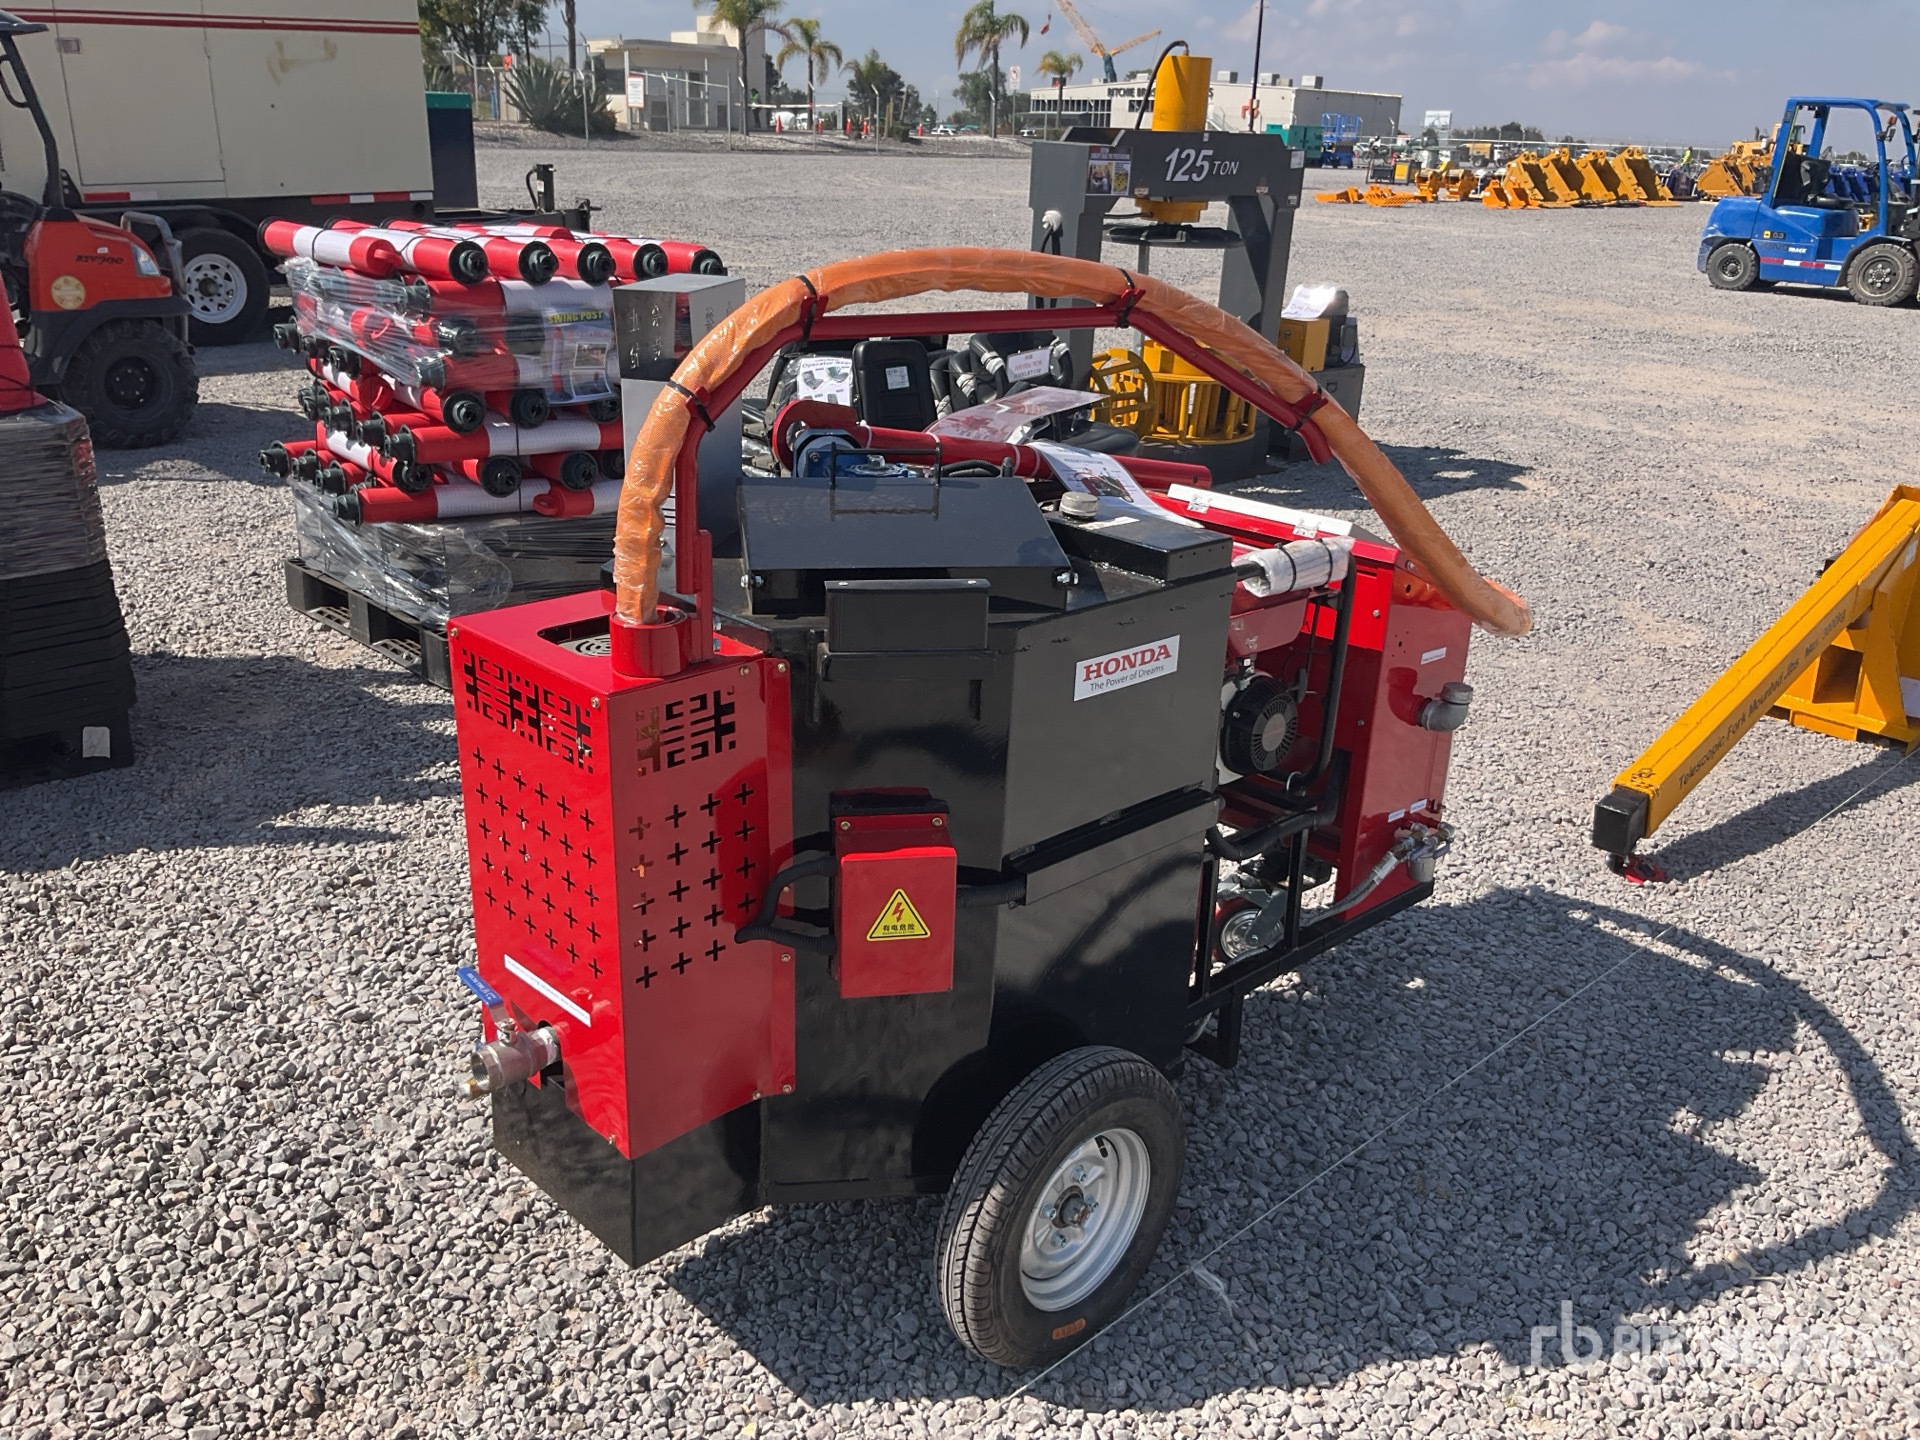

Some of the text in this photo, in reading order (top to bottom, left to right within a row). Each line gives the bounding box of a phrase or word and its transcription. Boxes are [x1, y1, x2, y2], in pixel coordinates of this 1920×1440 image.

[1107, 88, 1155, 97] RITCHIE BRS
[1164, 147, 1240, 182] 125 TON
[547, 310, 604, 324] SWING POST
[1082, 644, 1172, 682] HONDA
[1090, 665, 1165, 692] The Power of Dreams
[1725, 711, 1747, 741] Fork
